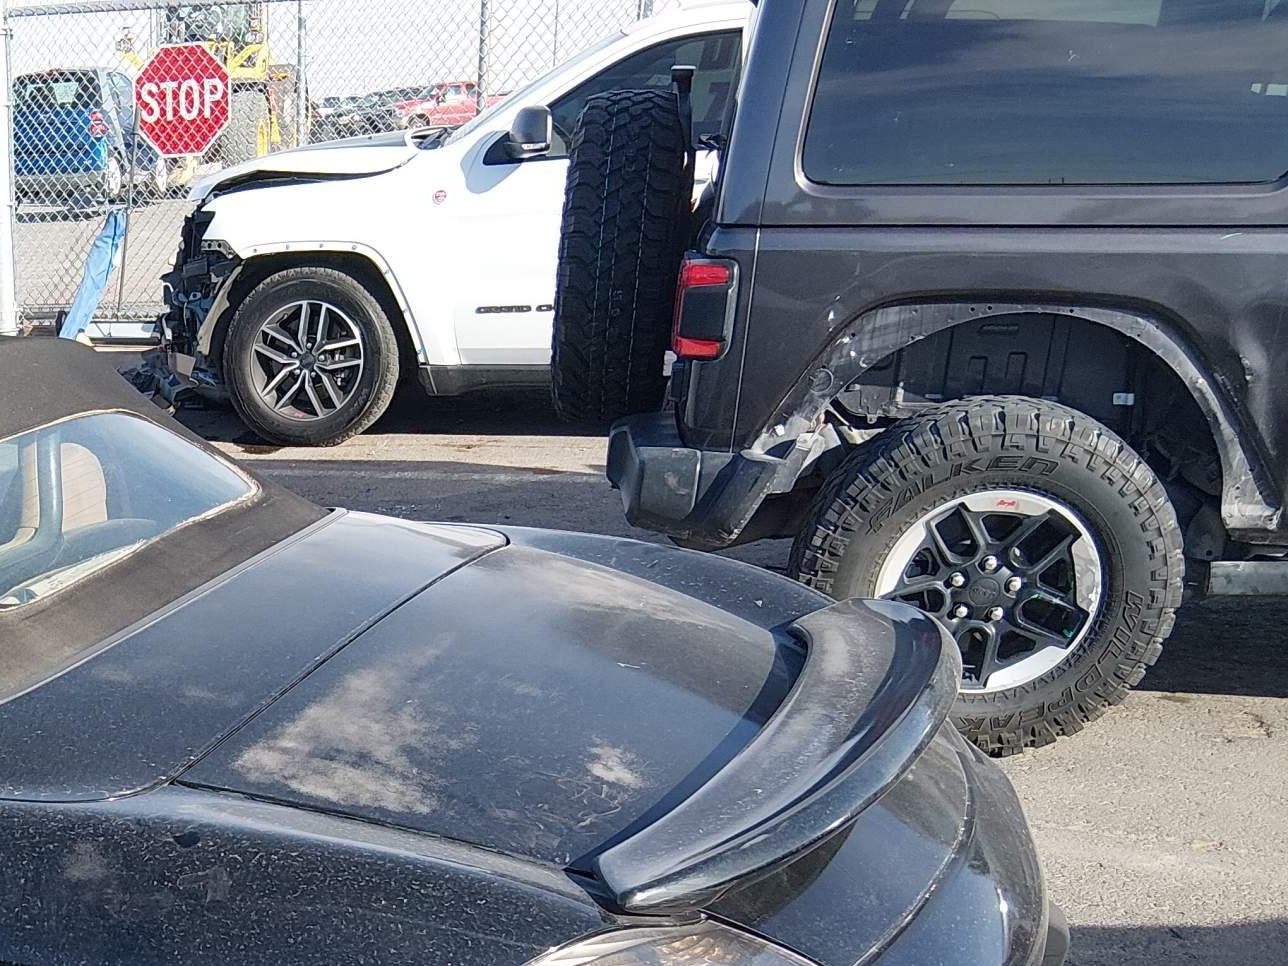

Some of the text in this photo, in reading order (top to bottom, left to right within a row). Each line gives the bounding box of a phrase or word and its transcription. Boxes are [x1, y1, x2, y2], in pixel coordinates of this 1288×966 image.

[141, 78, 224, 123] STOP
[865, 455, 1060, 536] FALKEN
[960, 591, 1145, 730] WILDPEAK
